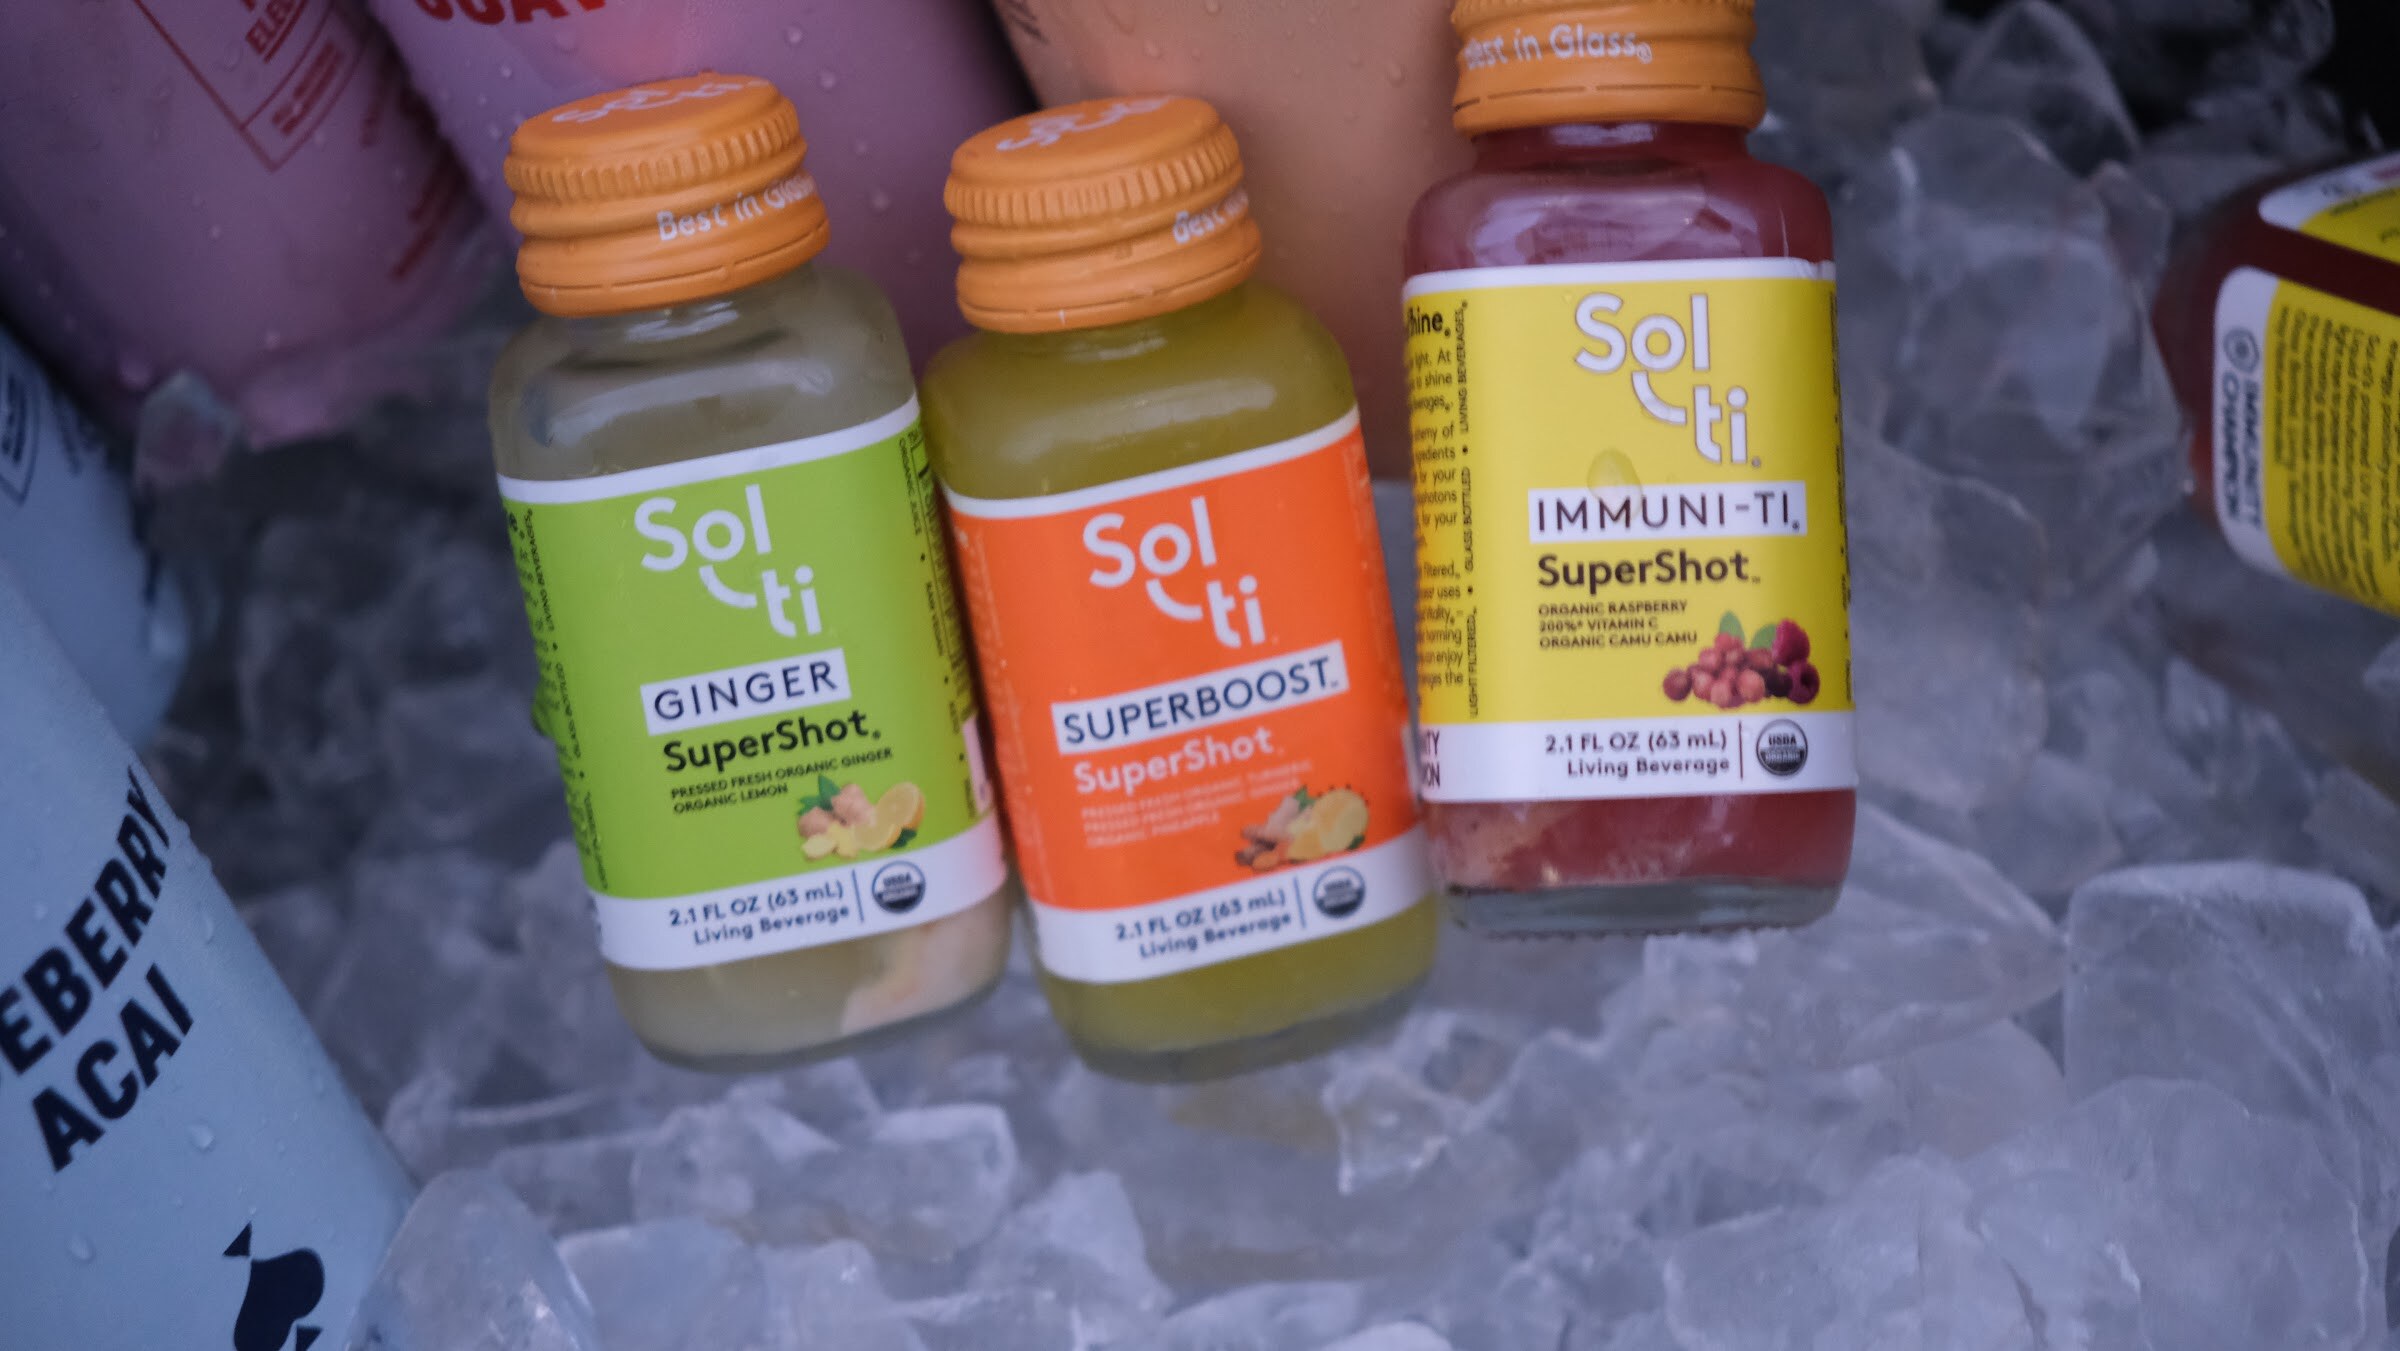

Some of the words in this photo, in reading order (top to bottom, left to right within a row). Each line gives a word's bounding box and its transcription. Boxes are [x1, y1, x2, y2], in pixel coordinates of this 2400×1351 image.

[1513, 28, 1542, 62] in
[656, 202, 729, 241] Best
[735, 192, 762, 223] in
[1573, 291, 1711, 375] Sol
[1692, 385, 1749, 466] ti
[634, 483, 772, 572] Sol
[1083, 495, 1218, 589] Sol
[1537, 549, 1750, 597] SuperShot
[761, 565, 823, 638] ti
[1206, 574, 1266, 649] ti
[1538, 601, 1604, 617] ORGANIC
[1608, 599, 1688, 615] RASPBERRY
[1588, 616, 1645, 631] VITAMIN
[1648, 616, 1658, 630] C
[1539, 634, 1608, 649] ORGANIC
[1609, 632, 1651, 648] CAMU
[1654, 631, 1698, 646] CAMU
[654, 660, 838, 720] GINGER
[1063, 655, 1330, 745] SUPERBOOST
[663, 709, 869, 773] SuperShot
[1072, 726, 1275, 797] SuperShot
[1544, 733, 1574, 755] 2.1
[1580, 732, 1604, 752] FL
[1609, 731, 1641, 751] OZ
[1687, 728, 1727, 751] mL)
[1768, 732, 1798, 746] USDA
[670, 778, 728, 800] PRESSED
[730, 771, 773, 789] FRESH
[775, 758, 839, 781] ORGANIC
[841, 747, 893, 769] GINGER
[1567, 756, 1629, 781] Living
[1636, 755, 1730, 780] Beverage
[673, 793, 738, 815] ORGANIC
[740, 782, 789, 802] LEMON
[668, 908, 698, 928] 2.1
[702, 903, 726, 922] FL
[730, 896, 760, 918] OZ
[805, 880, 844, 902] mL)
[693, 921, 755, 946] Living
[759, 904, 850, 935] Beverage
[1115, 922, 1143, 942] 2.1
[1149, 915, 1170, 935] FL
[1175, 907, 1204, 930] OZ
[1138, 934, 1199, 960] Living
[1203, 912, 1292, 945] Beverage
[32, 962, 194, 1173] ACAI
